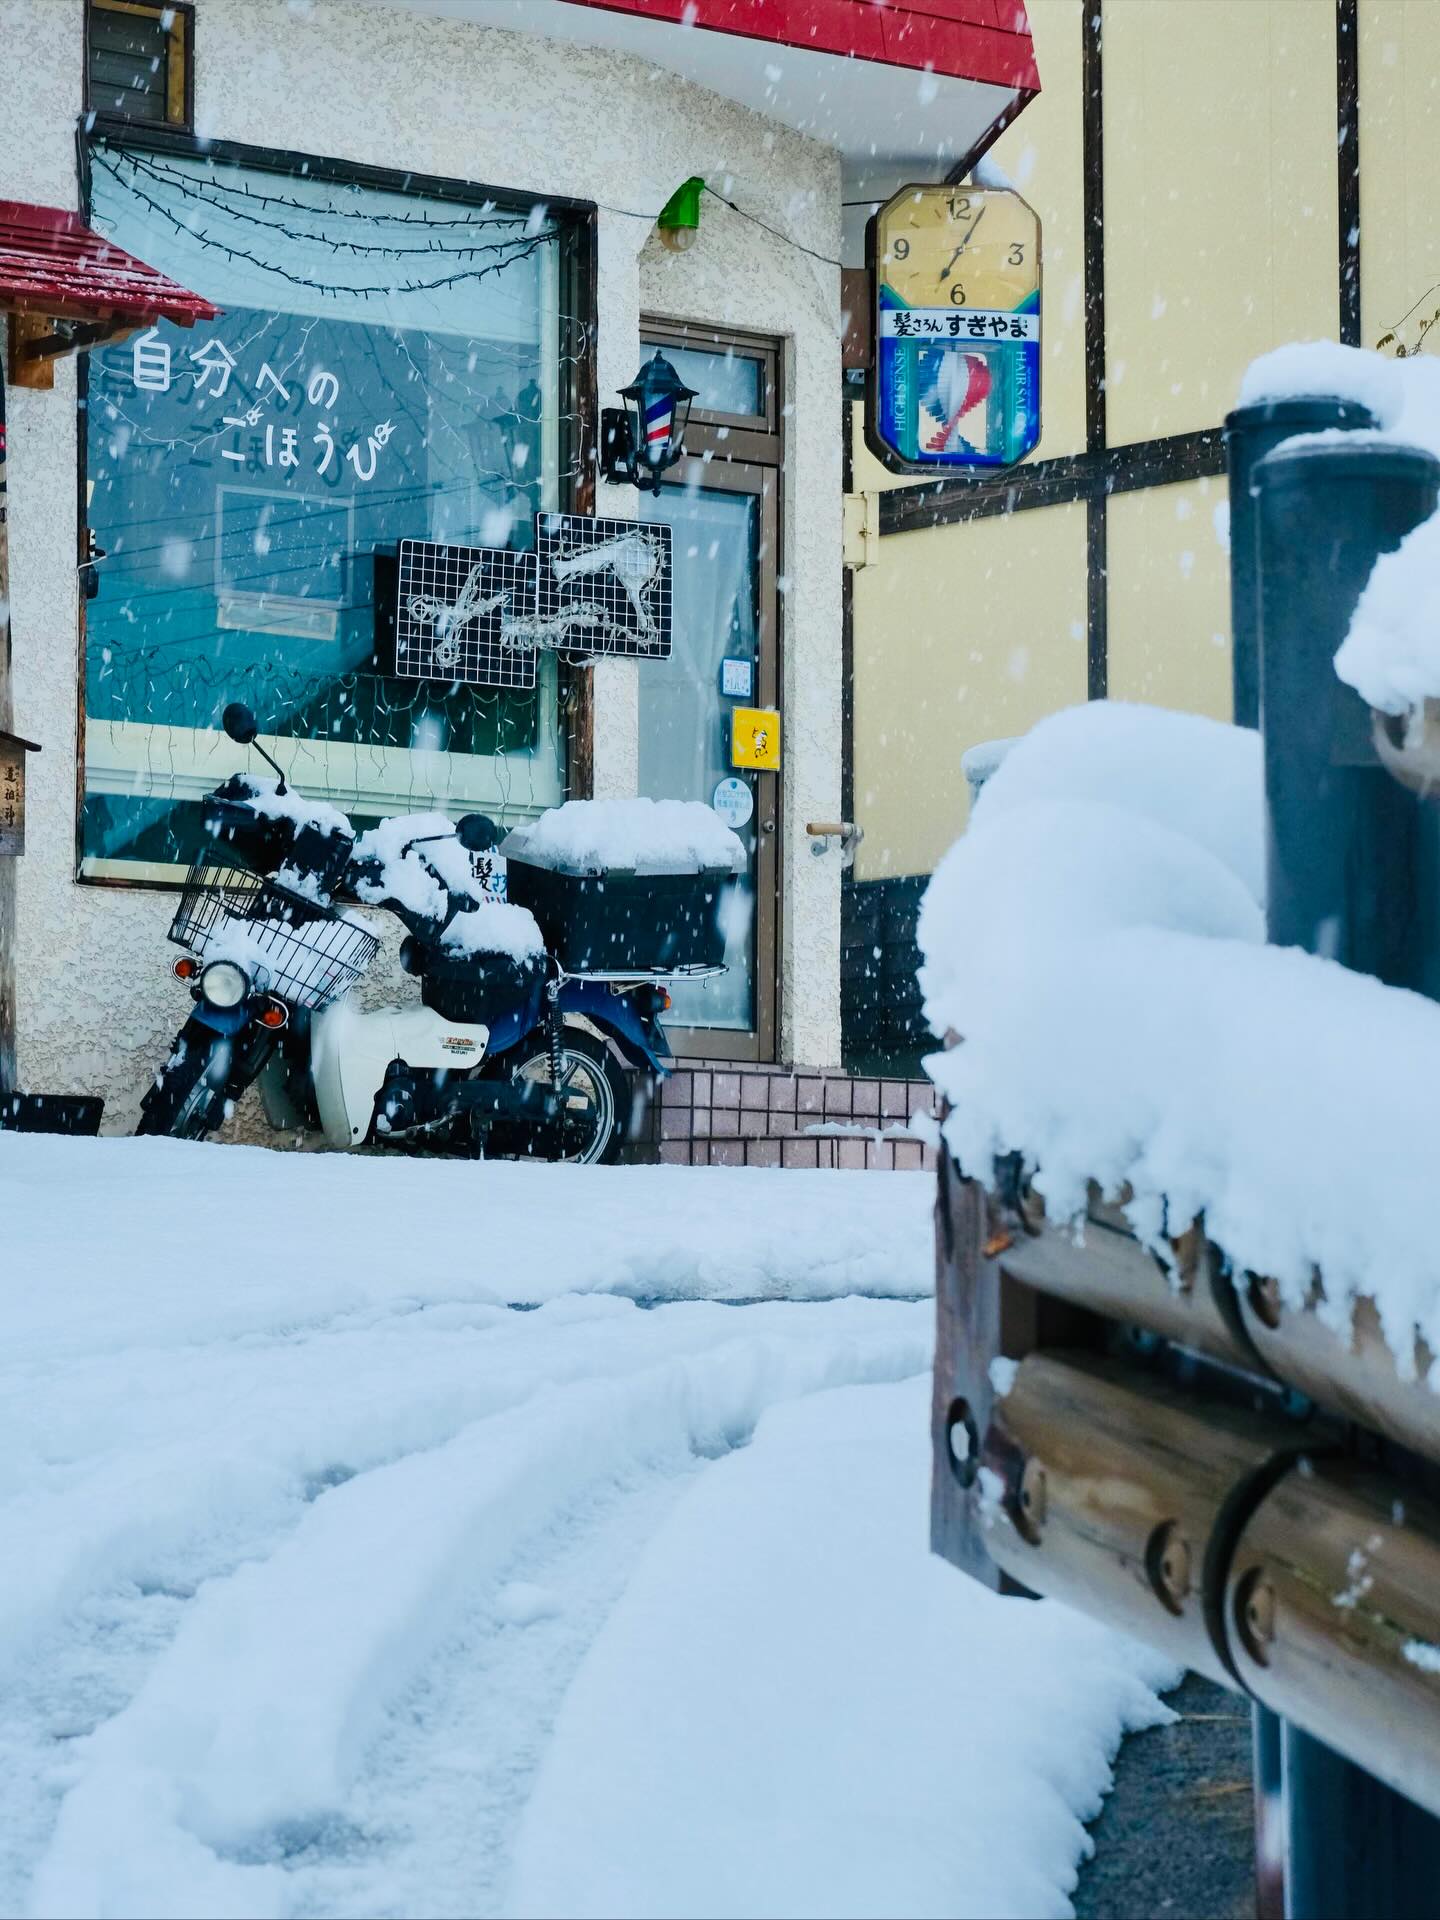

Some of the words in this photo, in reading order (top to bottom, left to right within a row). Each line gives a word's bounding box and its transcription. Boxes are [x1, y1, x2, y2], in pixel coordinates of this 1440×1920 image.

[946, 198, 972, 221] 12
[893, 238, 910, 261] 9
[1007, 243, 1025, 266] 3
[950, 283, 966, 306] 6
[133, 328, 339, 409] 自分への
[894, 347, 906, 392] SENSE
[1015, 351, 1026, 385] HAIR
[894, 394, 906, 432] HIGH
[221, 406, 398, 481] ごほうび
